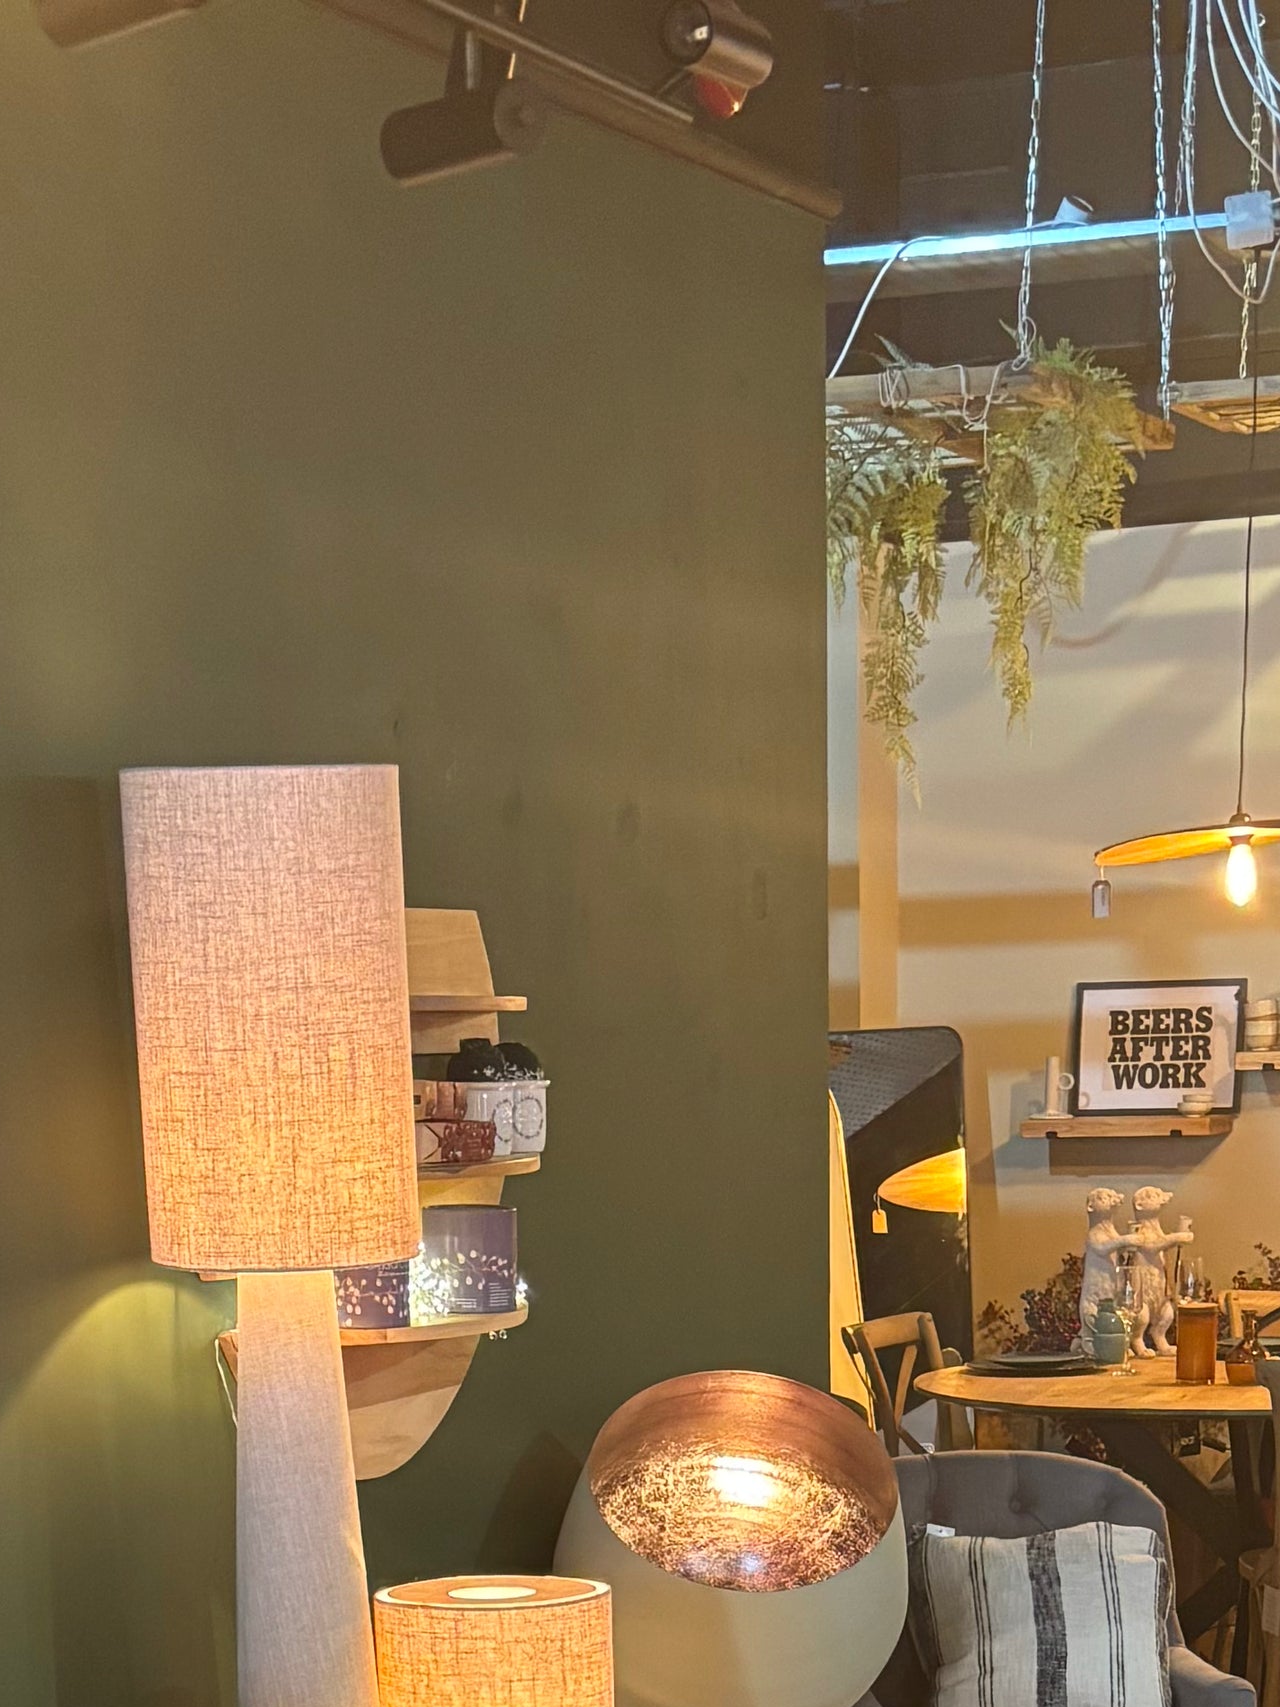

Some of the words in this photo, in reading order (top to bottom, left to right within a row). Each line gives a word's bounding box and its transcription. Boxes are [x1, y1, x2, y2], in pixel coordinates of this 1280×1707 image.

[1109, 1006, 1213, 1036] BEERS
[1108, 1034, 1212, 1062] AFTER
[1111, 1062, 1207, 1090] WORK
